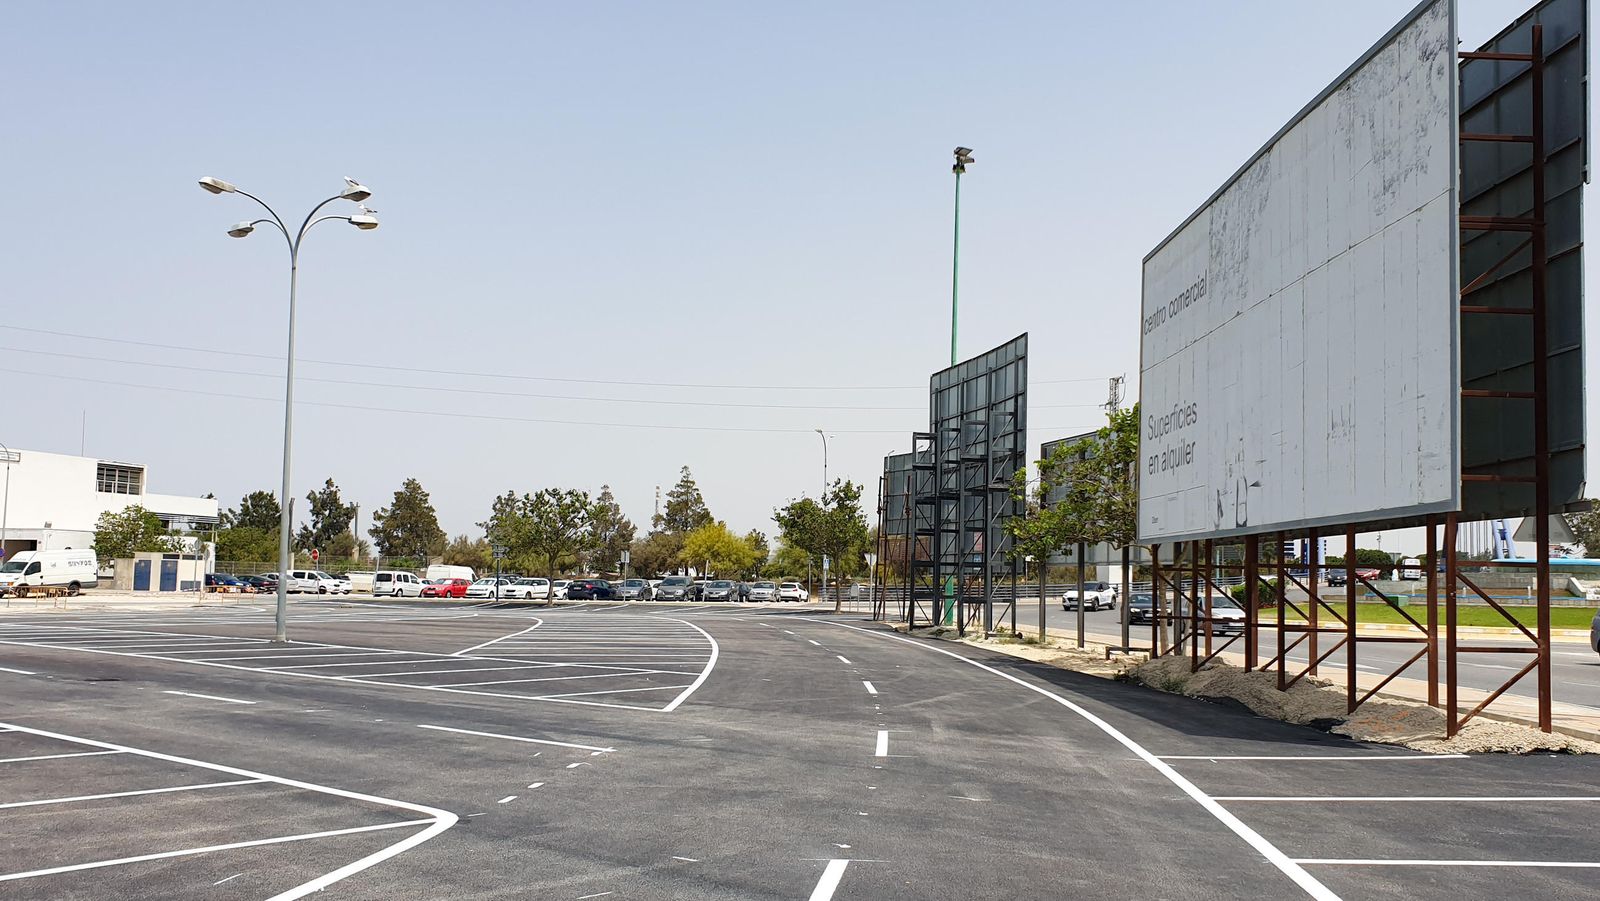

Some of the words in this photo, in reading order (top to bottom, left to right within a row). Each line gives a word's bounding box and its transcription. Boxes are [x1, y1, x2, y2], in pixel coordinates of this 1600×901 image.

[1144, 306, 1167, 336] centro
[1169, 269, 1208, 318] comercial
[1148, 400, 1197, 444] Superficies
[1149, 454, 1159, 476] en
[1161, 438, 1196, 476] alquiler
